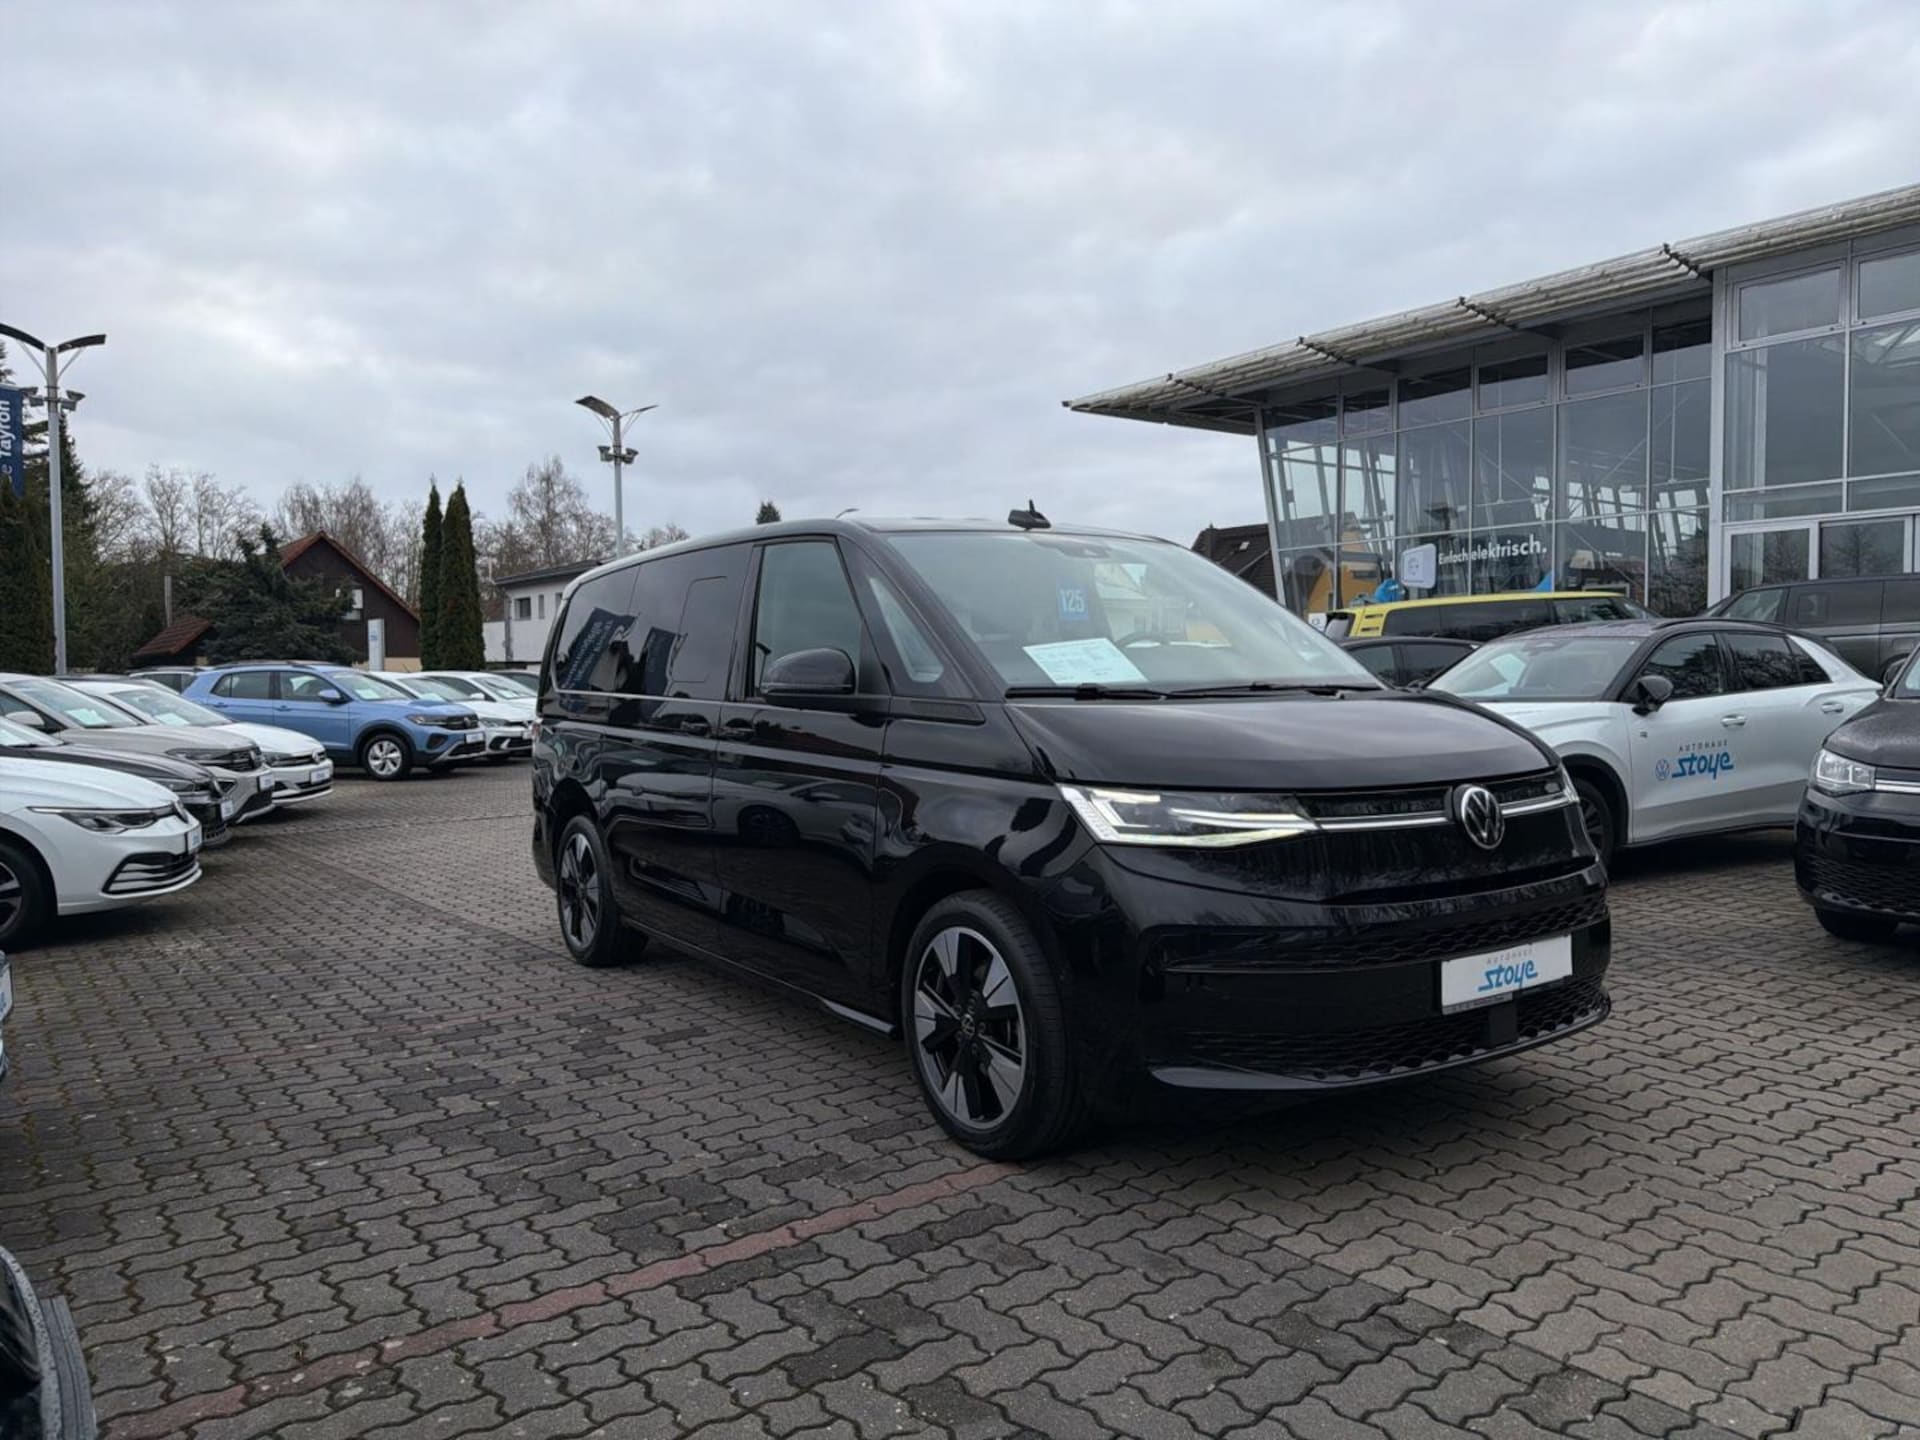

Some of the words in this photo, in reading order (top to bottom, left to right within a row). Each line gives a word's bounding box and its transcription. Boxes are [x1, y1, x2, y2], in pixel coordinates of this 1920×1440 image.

[1438, 548, 1468, 566] Einfach
[1470, 533, 1548, 561] elektrisch.
[1060, 588, 1086, 613] 125
